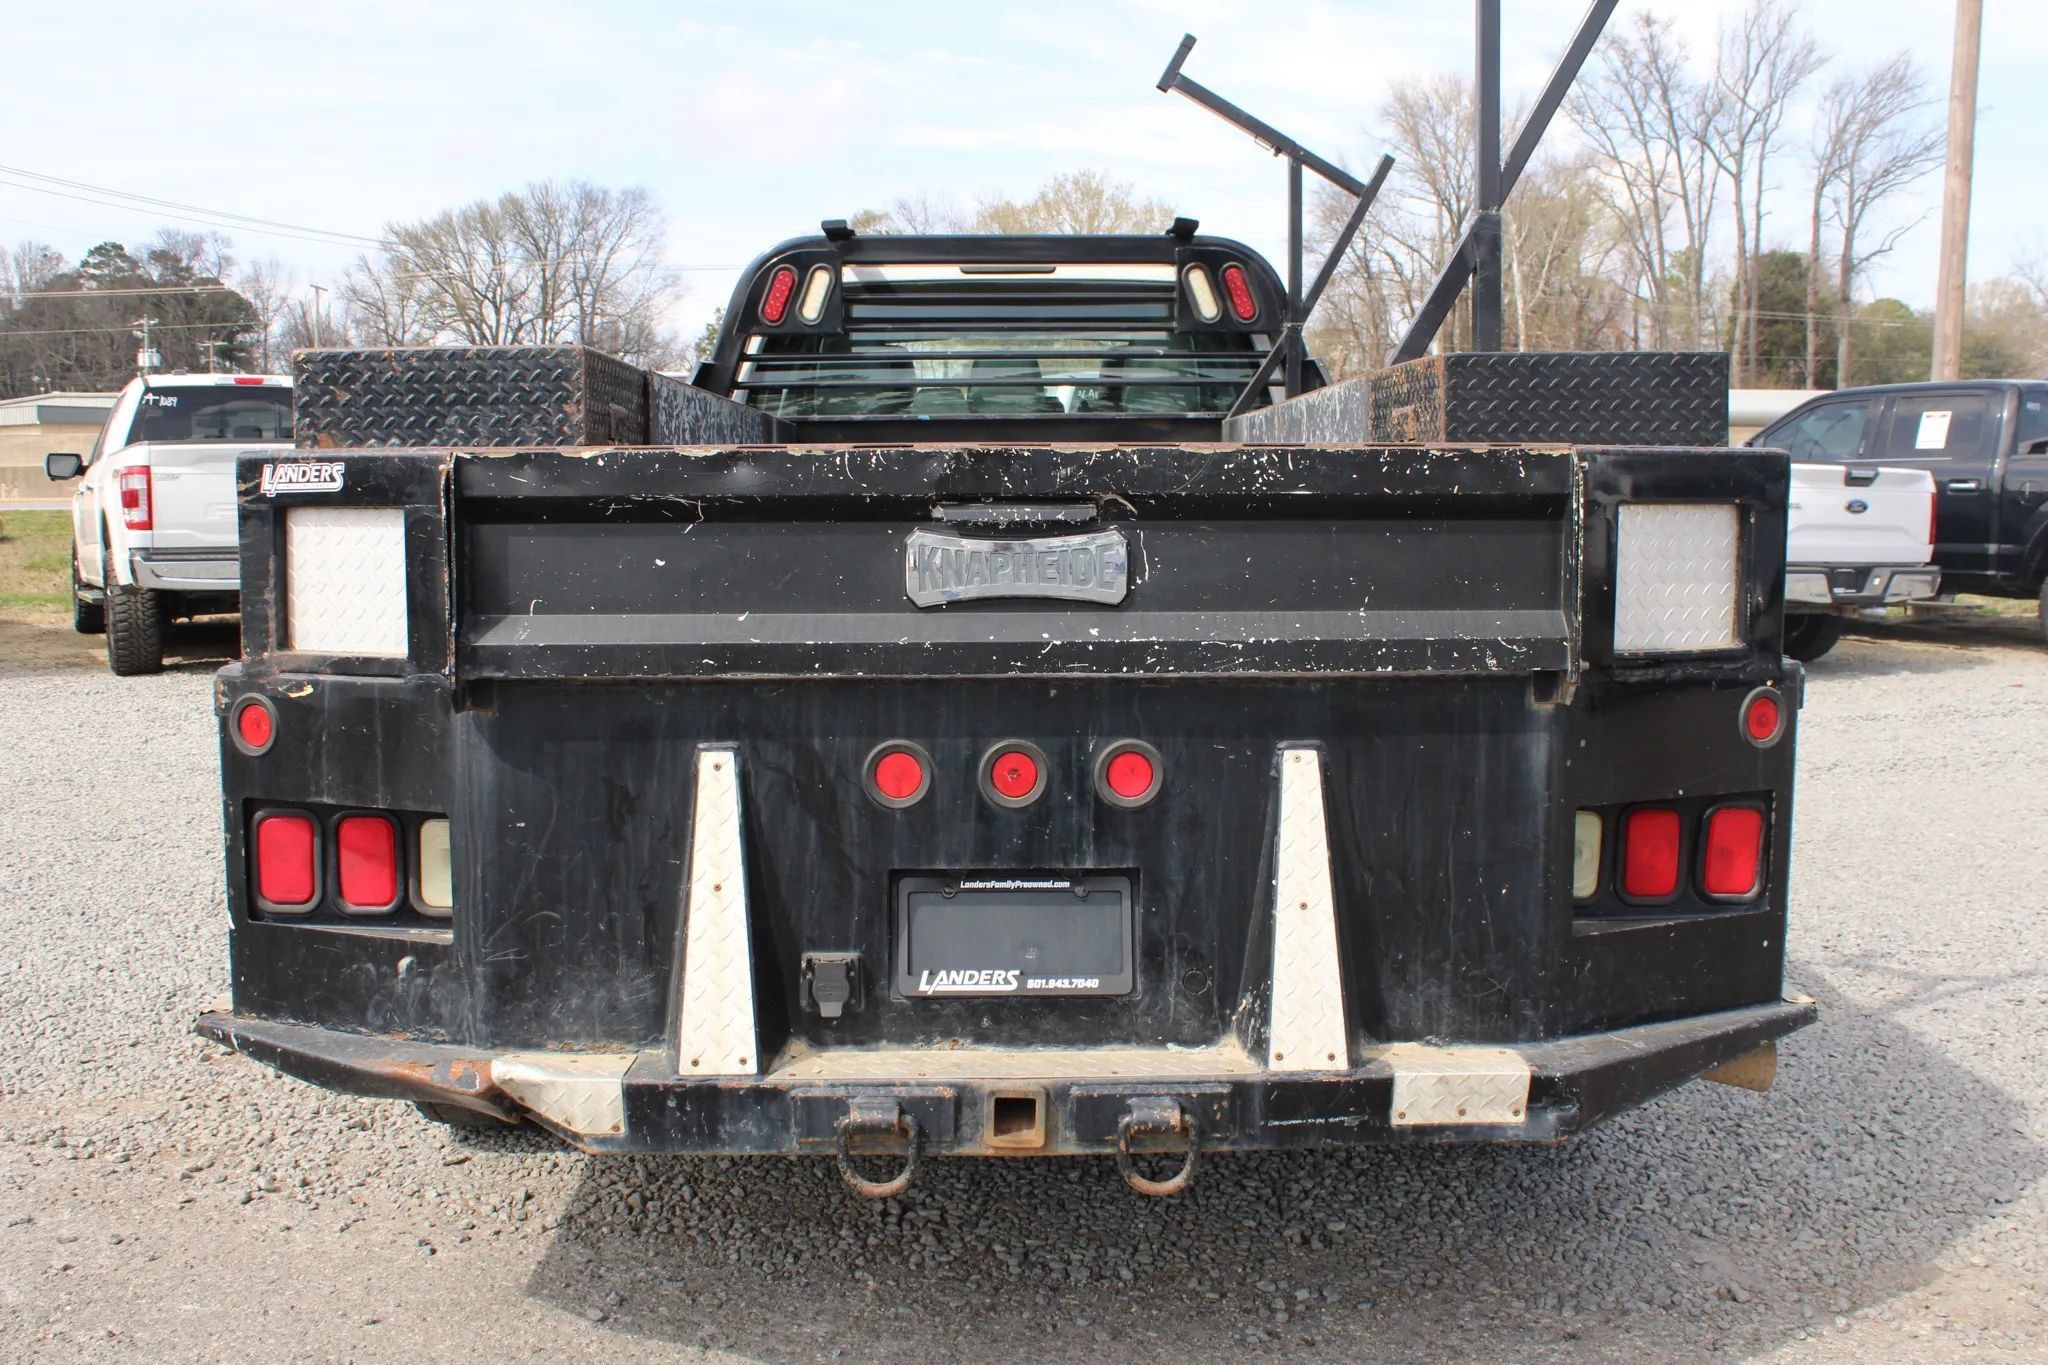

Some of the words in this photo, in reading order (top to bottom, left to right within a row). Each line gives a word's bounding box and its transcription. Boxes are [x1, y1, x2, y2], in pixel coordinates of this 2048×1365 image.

[261, 463, 345, 497] LANDERS
[917, 544, 1123, 593] KNAPHEIDE
[960, 880, 1070, 889] LandersFamilyPreowned.com
[918, 969, 1020, 995] LANDERS
